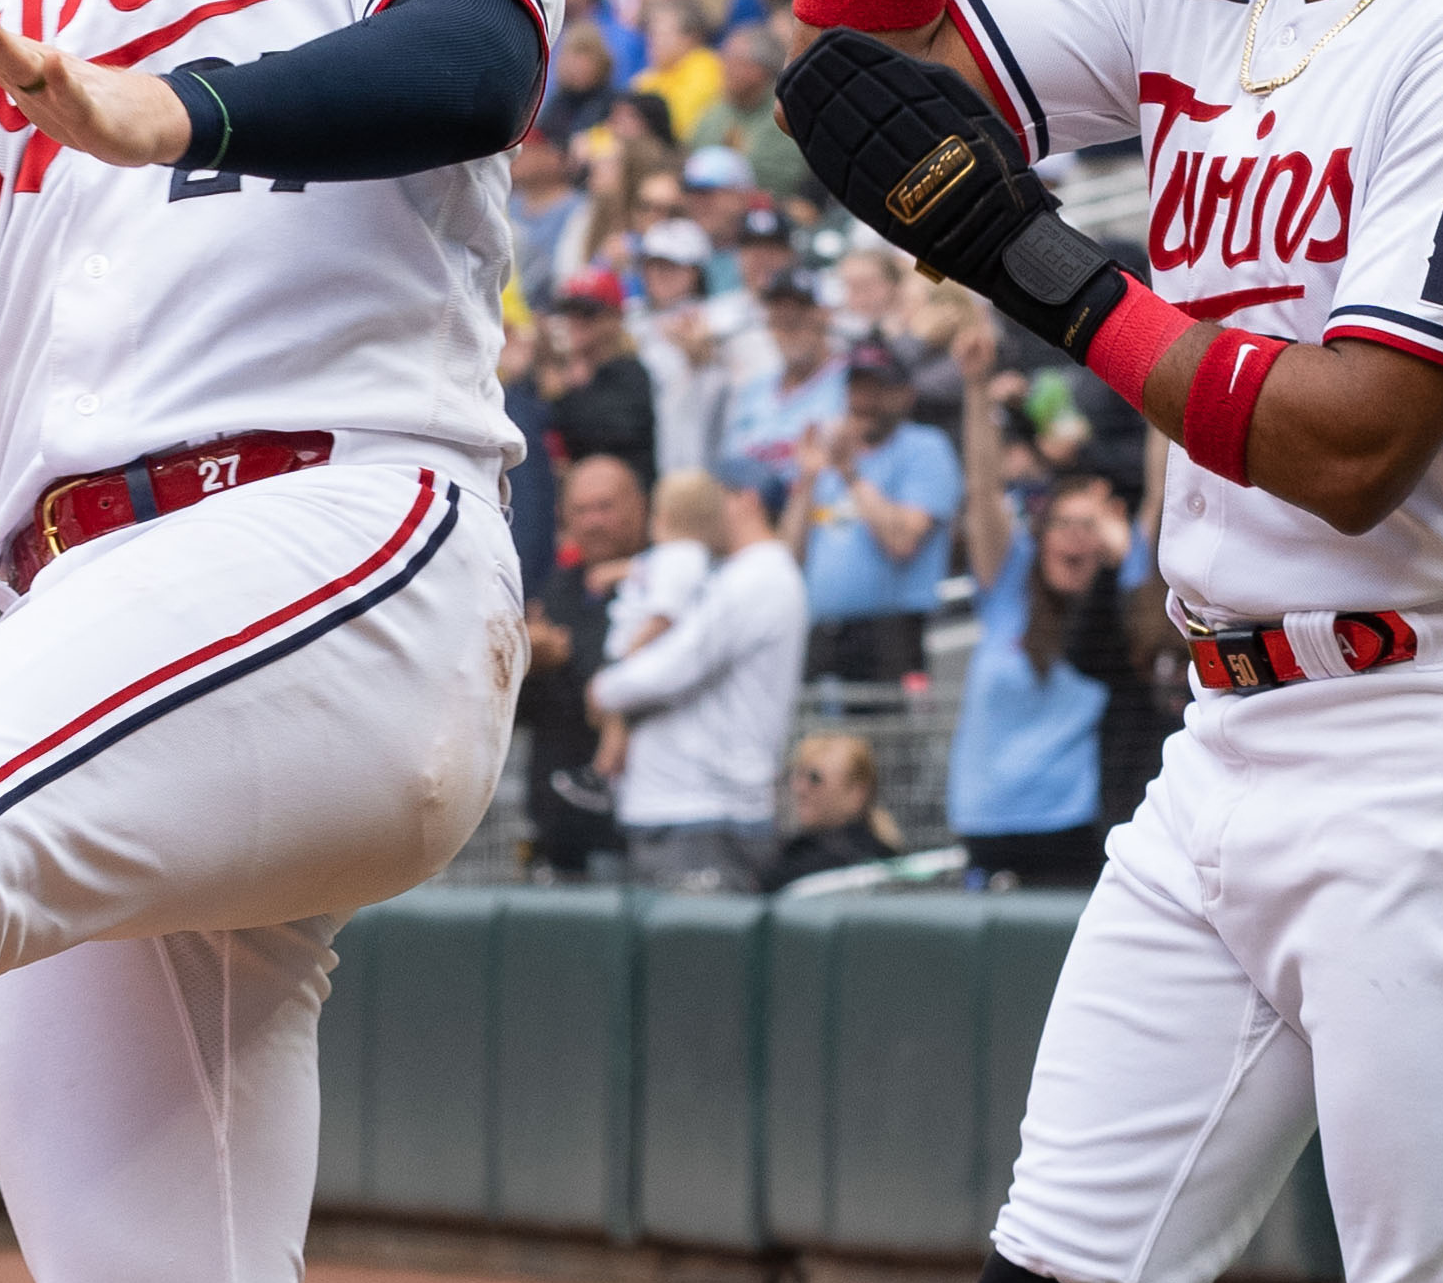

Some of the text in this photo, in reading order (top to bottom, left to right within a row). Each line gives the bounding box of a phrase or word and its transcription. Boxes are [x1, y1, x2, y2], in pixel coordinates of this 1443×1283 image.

[1139, 72, 1354, 273] Twins
[197, 454, 241, 493] 27
[1226, 652, 1259, 687] 50
